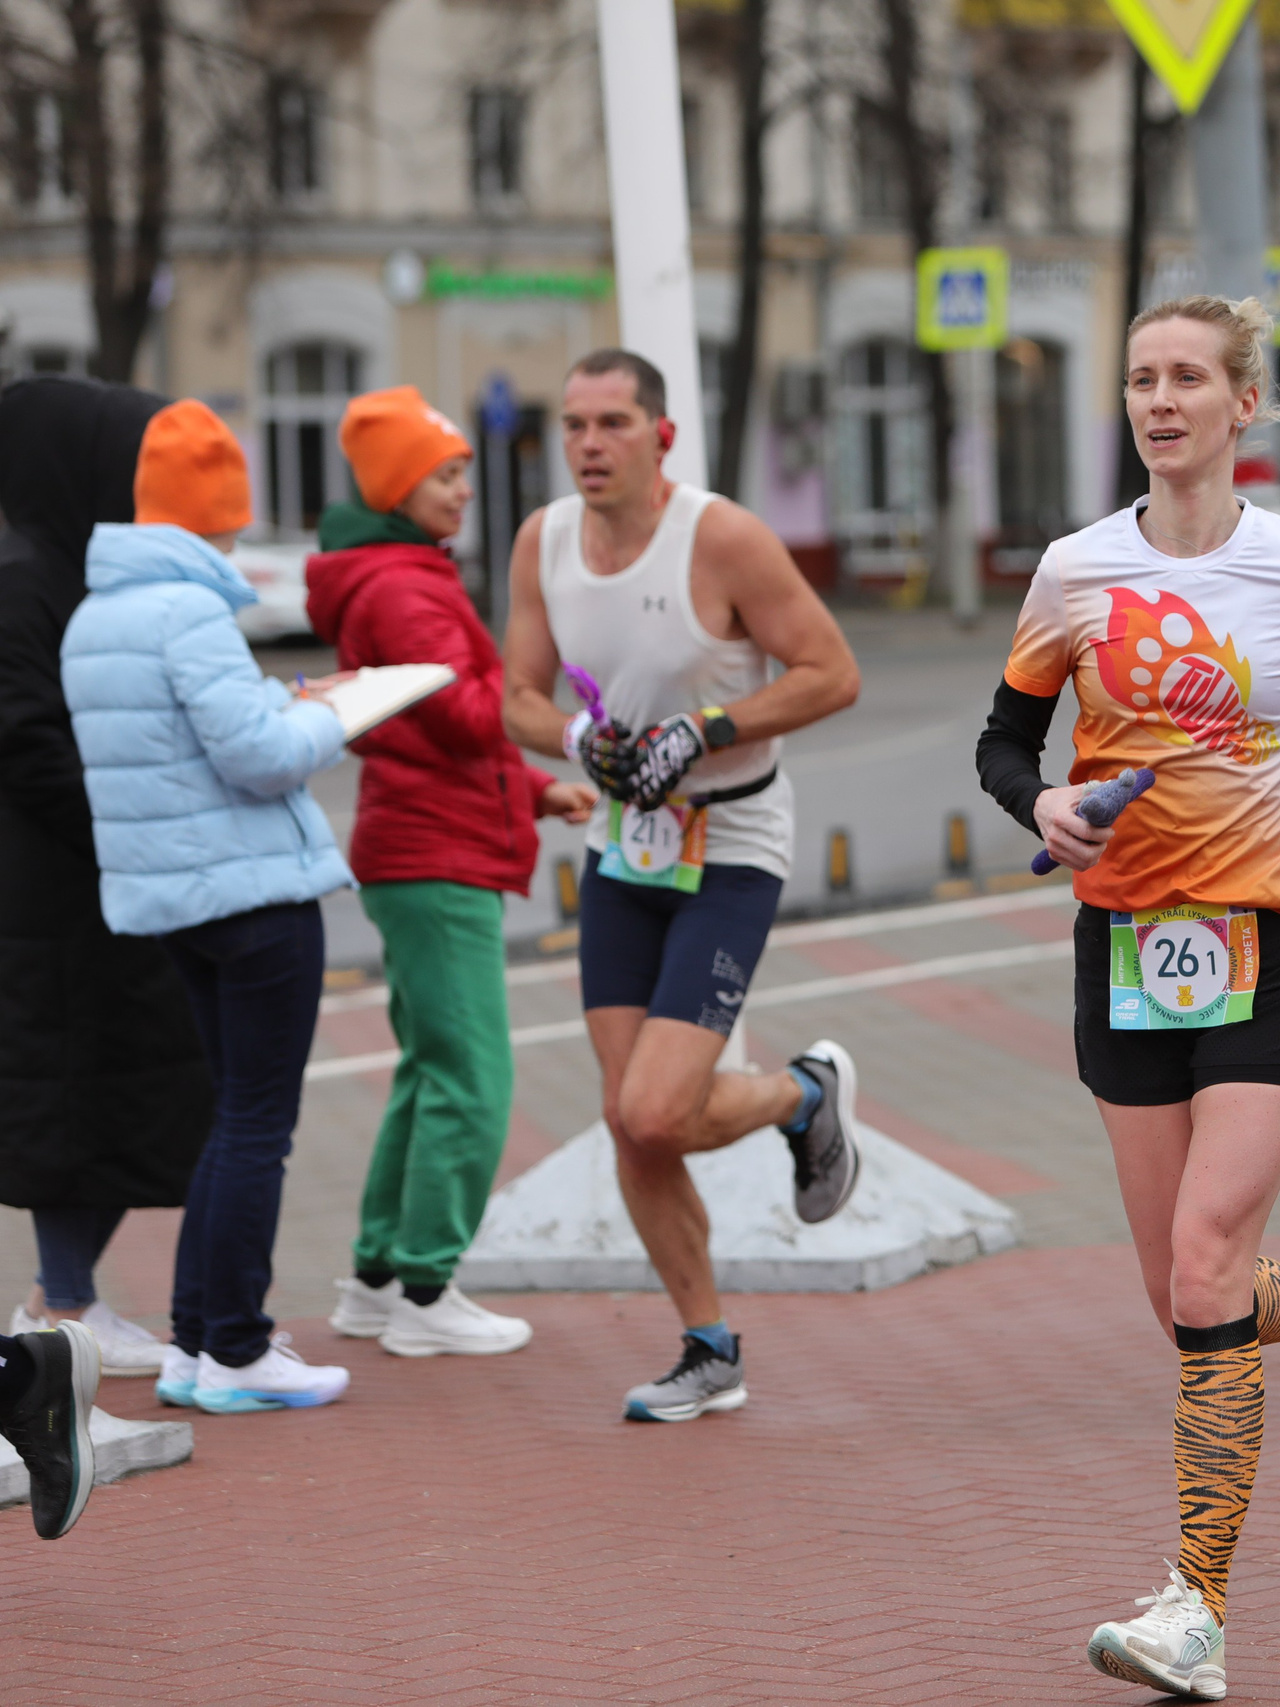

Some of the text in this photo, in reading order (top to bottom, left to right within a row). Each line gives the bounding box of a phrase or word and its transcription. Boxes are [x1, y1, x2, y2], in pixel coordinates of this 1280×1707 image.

[631, 811, 656, 844] 21
[662, 827, 670, 847] 1
[1138, 909, 1223, 940] DREAM TRAIL LYSKOVO
[1154, 937, 1216, 978] 26 1
[1242, 927, 1254, 983] ЭСТАФЕТА
[1136, 978, 1152, 1005] ULTRA
[1199, 946, 1238, 1021] ХИМКИНСКИЙ ЛЕС
[1151, 1003, 1184, 1024] KANNAS
